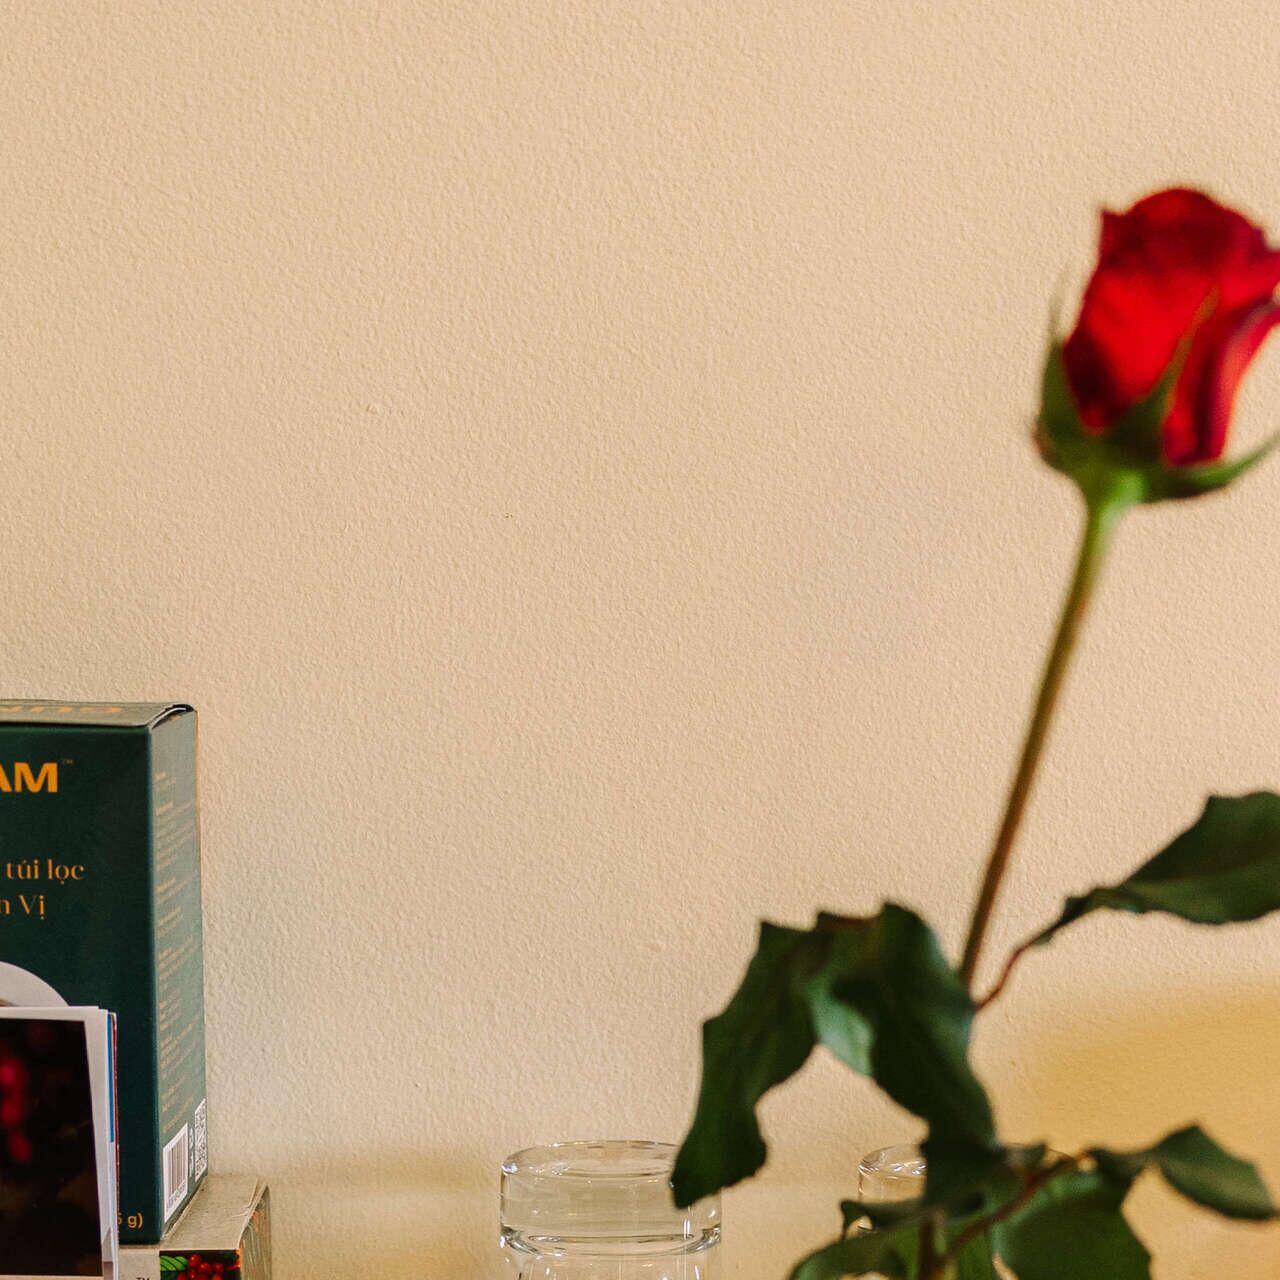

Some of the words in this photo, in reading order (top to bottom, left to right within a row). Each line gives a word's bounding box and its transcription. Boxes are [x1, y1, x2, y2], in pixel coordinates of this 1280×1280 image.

[6, 859, 40, 880] túi
[47, 858, 85, 885] lọc
[18, 894, 46, 920] Vị
